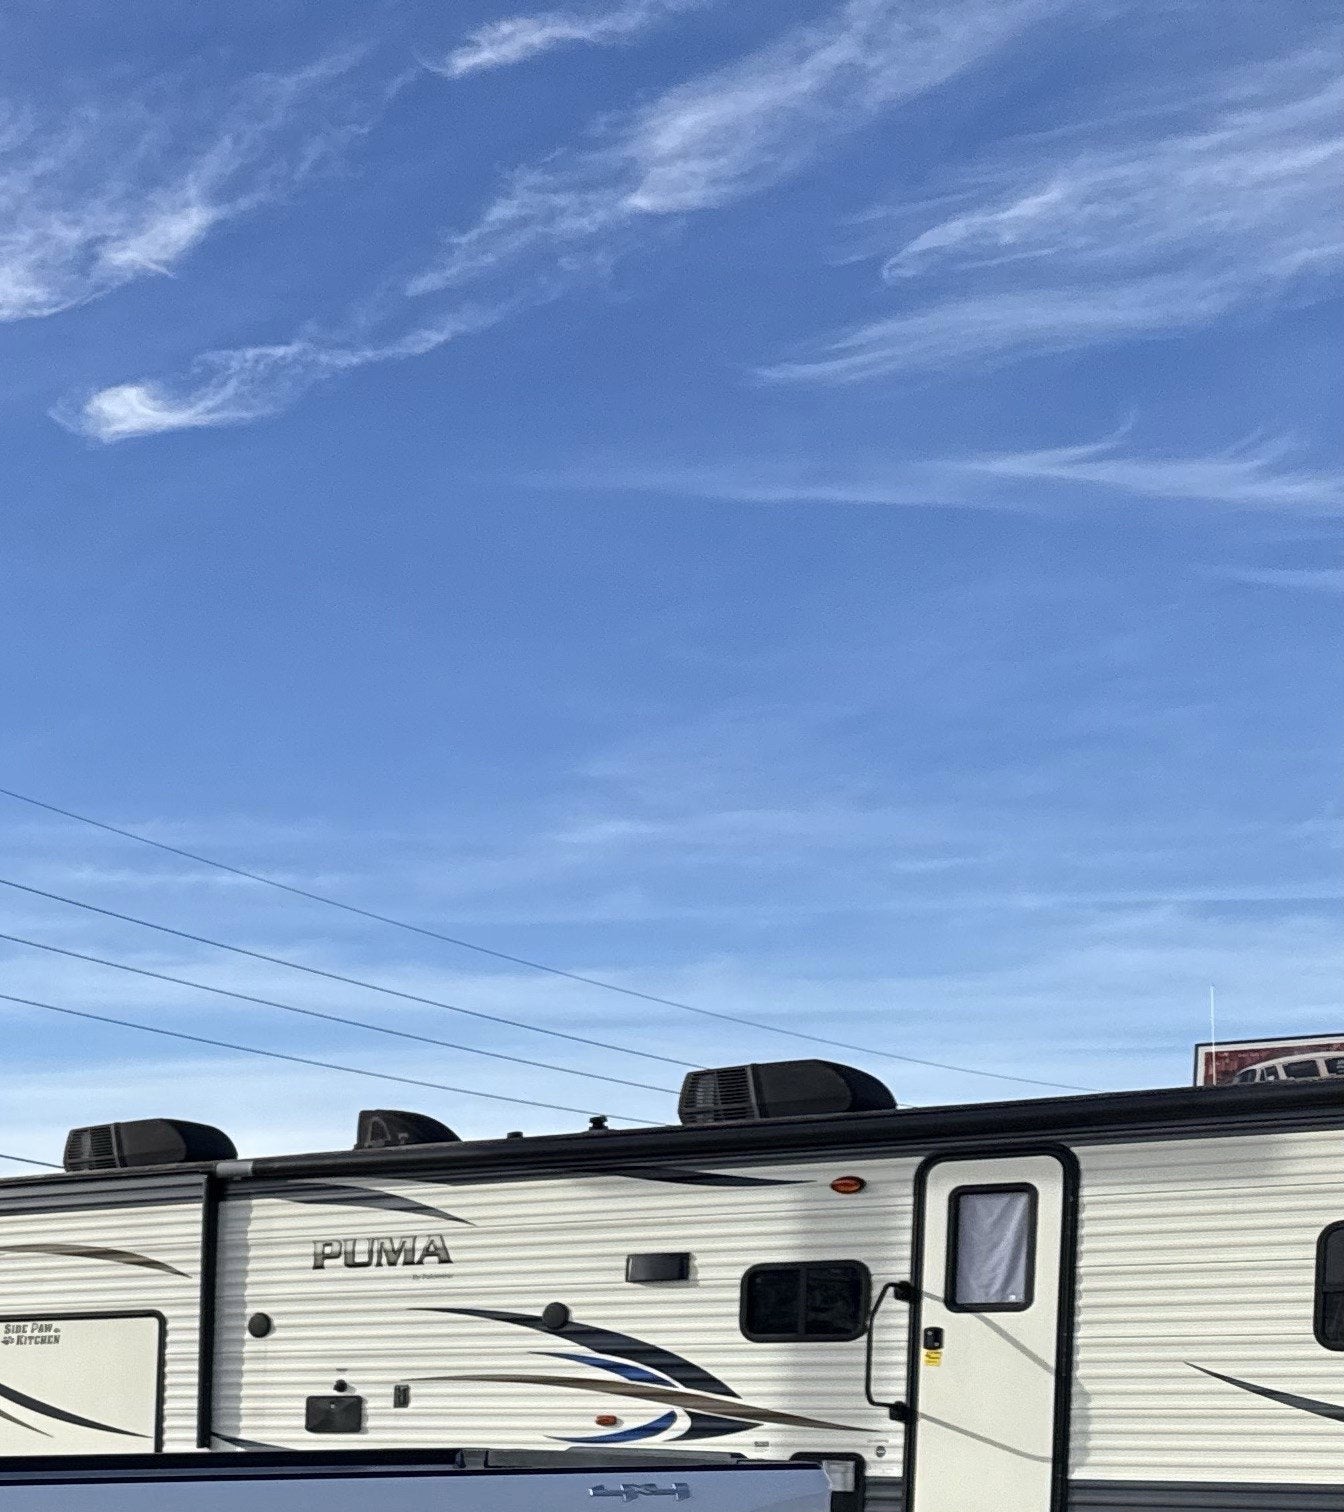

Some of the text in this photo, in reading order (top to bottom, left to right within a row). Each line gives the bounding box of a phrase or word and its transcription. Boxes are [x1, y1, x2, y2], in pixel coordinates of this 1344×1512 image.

[312, 1234, 454, 1270] PUMA
[4, 1322, 54, 1334] SIDE PAW
[16, 1335, 61, 1345] KITCHEN
